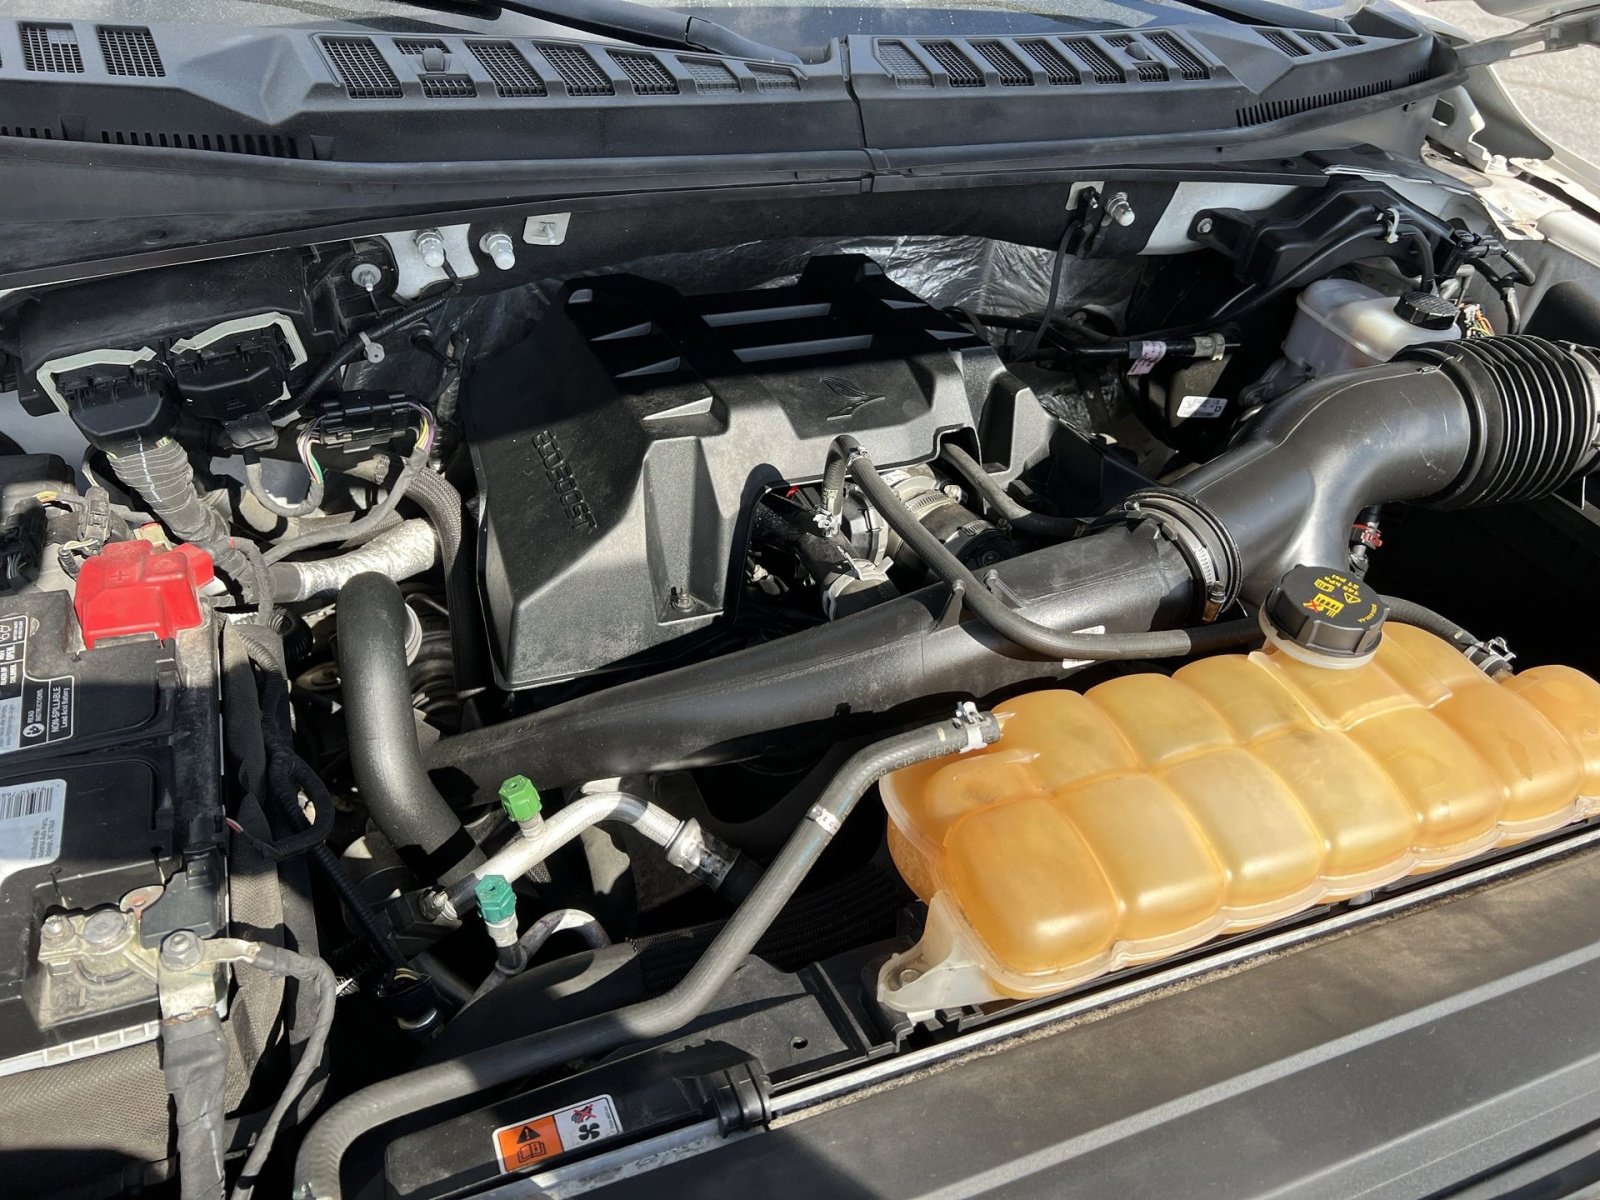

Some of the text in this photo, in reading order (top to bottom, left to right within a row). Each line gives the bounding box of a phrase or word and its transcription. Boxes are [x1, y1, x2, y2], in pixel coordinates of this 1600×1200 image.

[532, 429, 597, 531] ECOBOOST
[62, 687, 70, 705] Battery
[27, 710, 35, 724] READ
[51, 686, 61, 733] NON-SPILLABLE
[61, 705, 69, 716] Acid
